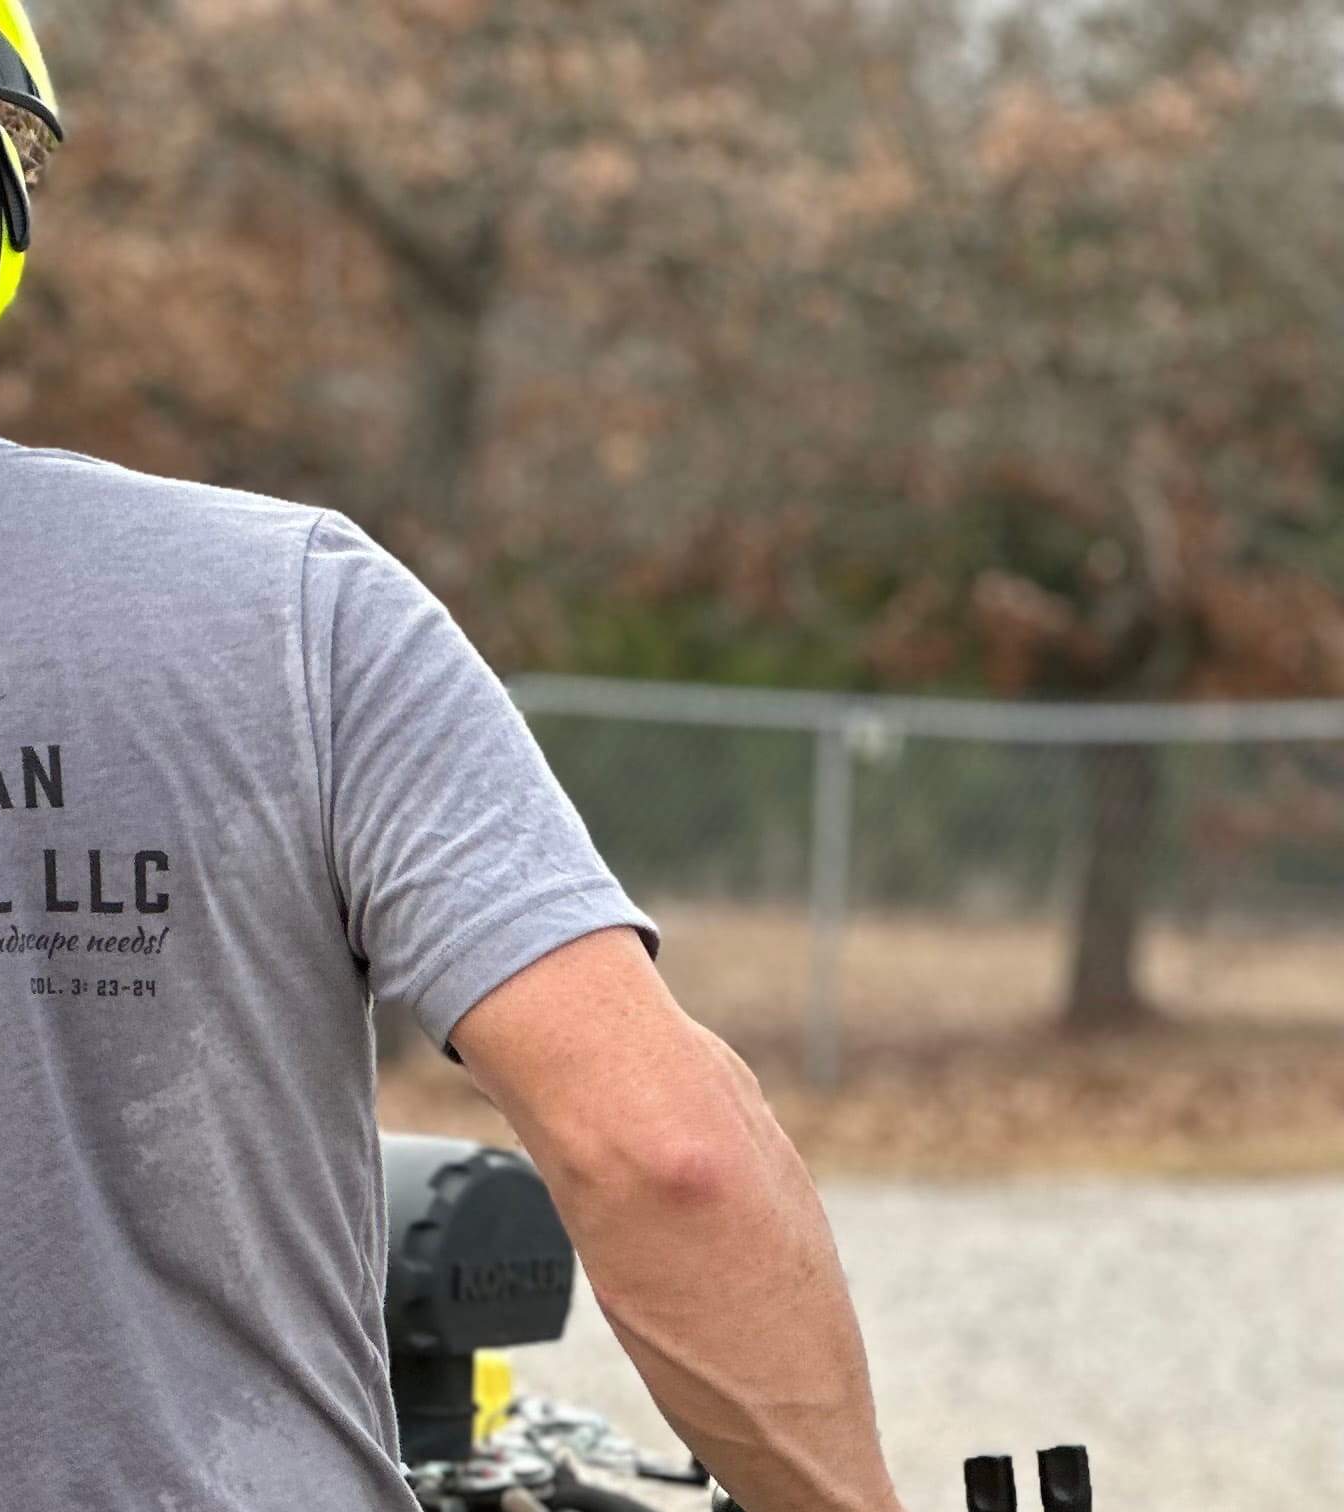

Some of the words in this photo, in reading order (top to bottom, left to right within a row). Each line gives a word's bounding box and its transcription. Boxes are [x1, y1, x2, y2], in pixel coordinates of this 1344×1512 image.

[43, 849, 169, 915] LLC
[86, 926, 169, 954] needs!
[30, 977, 64, 995] COL.
[71, 978, 88, 996] 3:
[97, 979, 156, 997] 23-24
